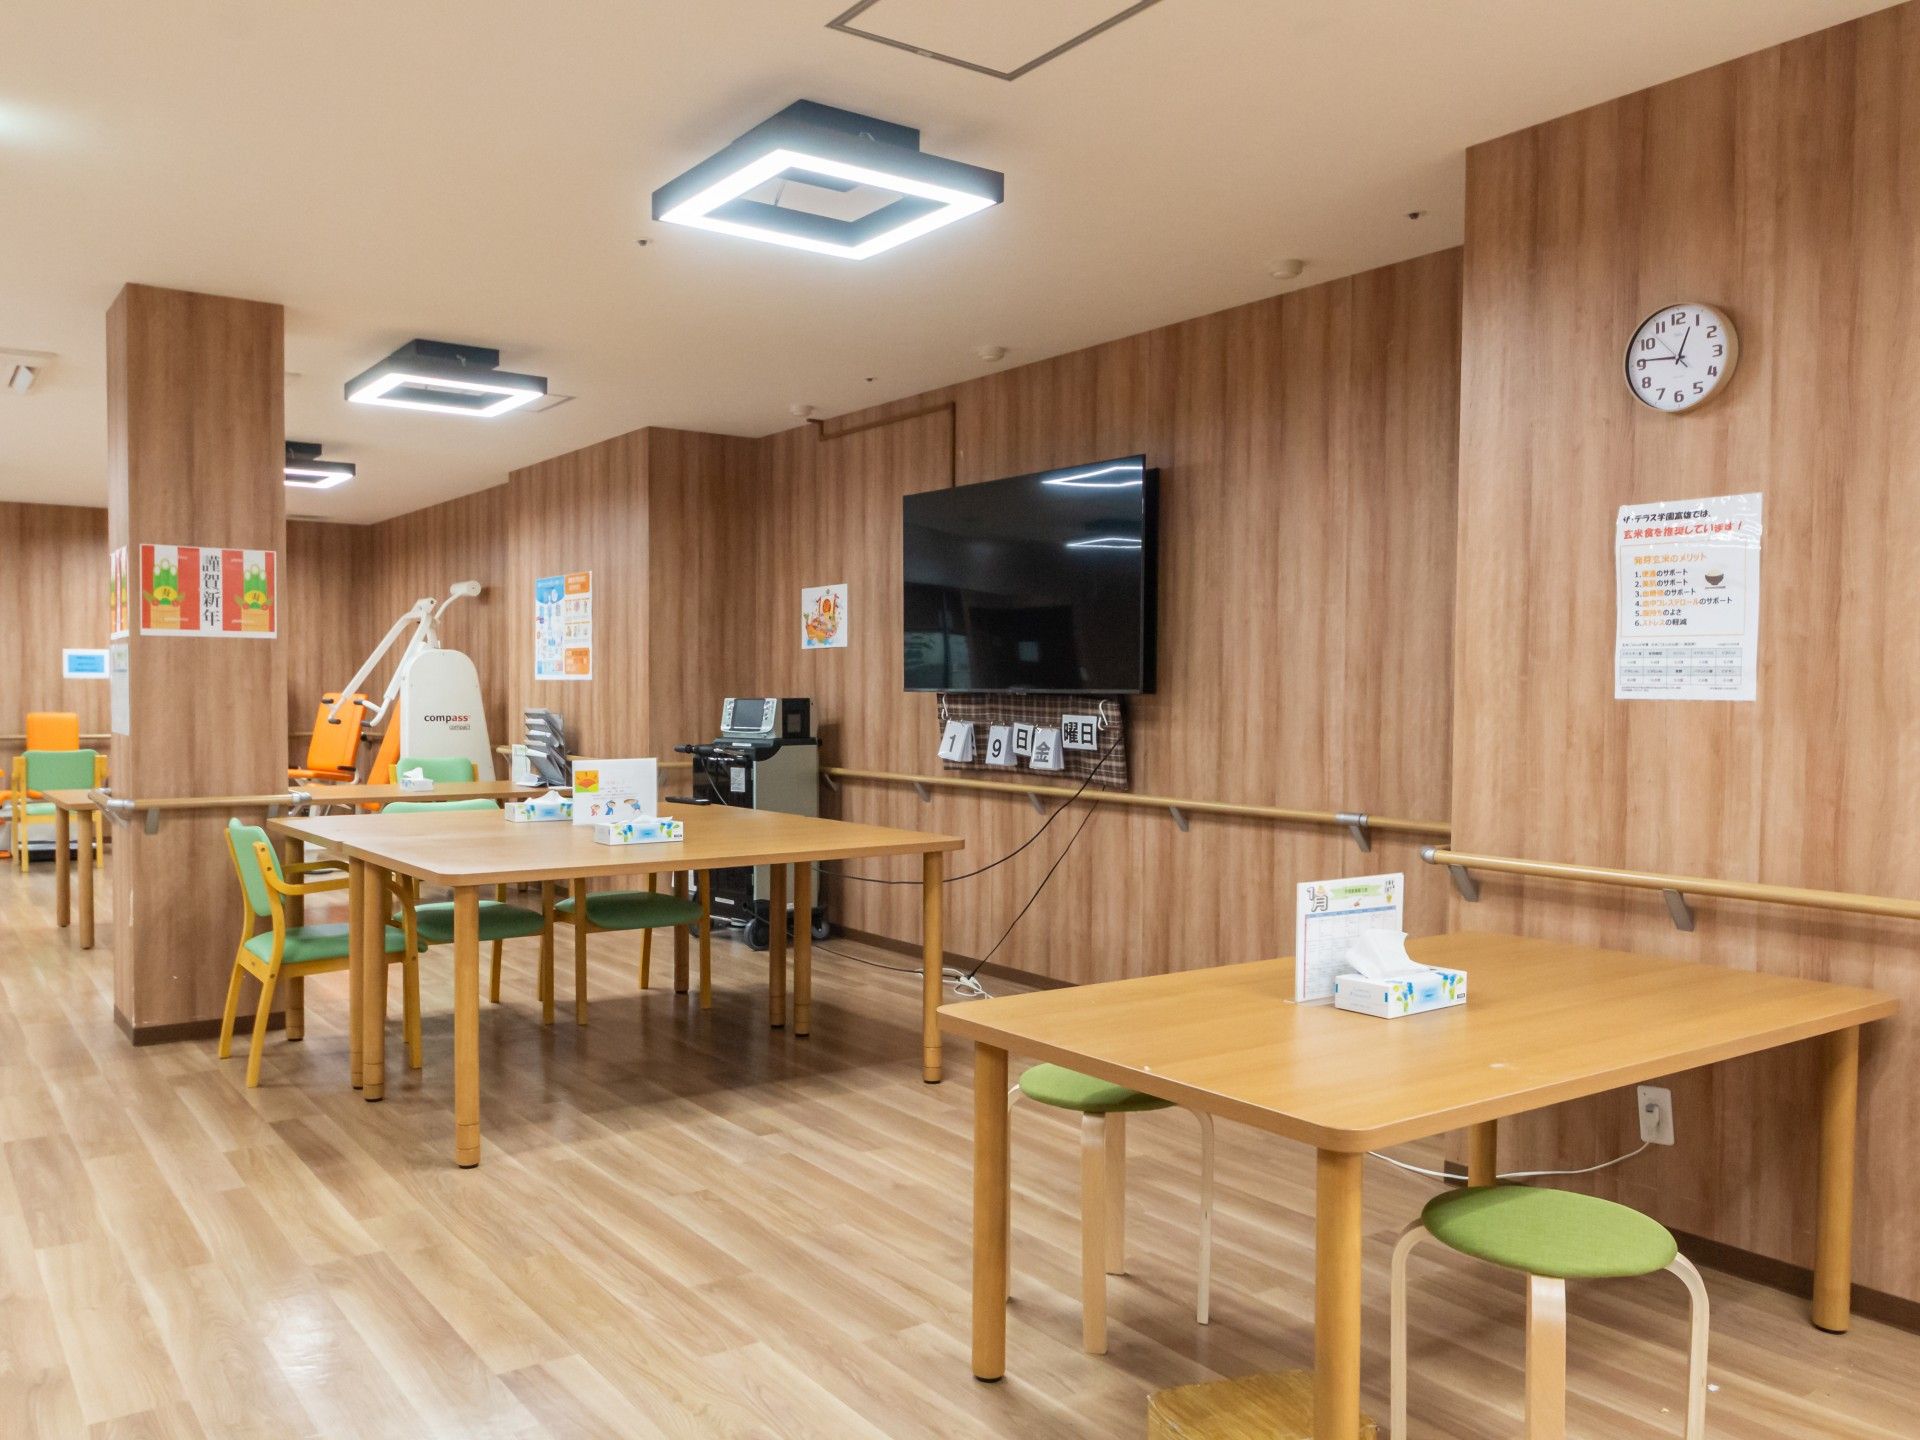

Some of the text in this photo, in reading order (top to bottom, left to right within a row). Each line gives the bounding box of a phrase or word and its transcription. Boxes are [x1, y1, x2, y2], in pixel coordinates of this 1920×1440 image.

[1671, 312, 1686, 326] 12
[1695, 314, 1700, 327] 1
[1656, 321, 1665, 334] 11
[1706, 325, 1718, 339] 2
[1640, 337, 1656, 351] 10
[1712, 344, 1723, 357] 3
[1636, 358, 1647, 371] 9
[1707, 365, 1718, 377] 4
[1641, 376, 1652, 389] 8
[1692, 381, 1704, 394] 5
[1656, 387, 1666, 400] 7
[1674, 390, 1685, 403] 6
[202, 554, 220, 627] 謹賀新年
[424, 714, 468, 723] compass
[948, 721, 1094, 763] 1 9 日 金 曜日
